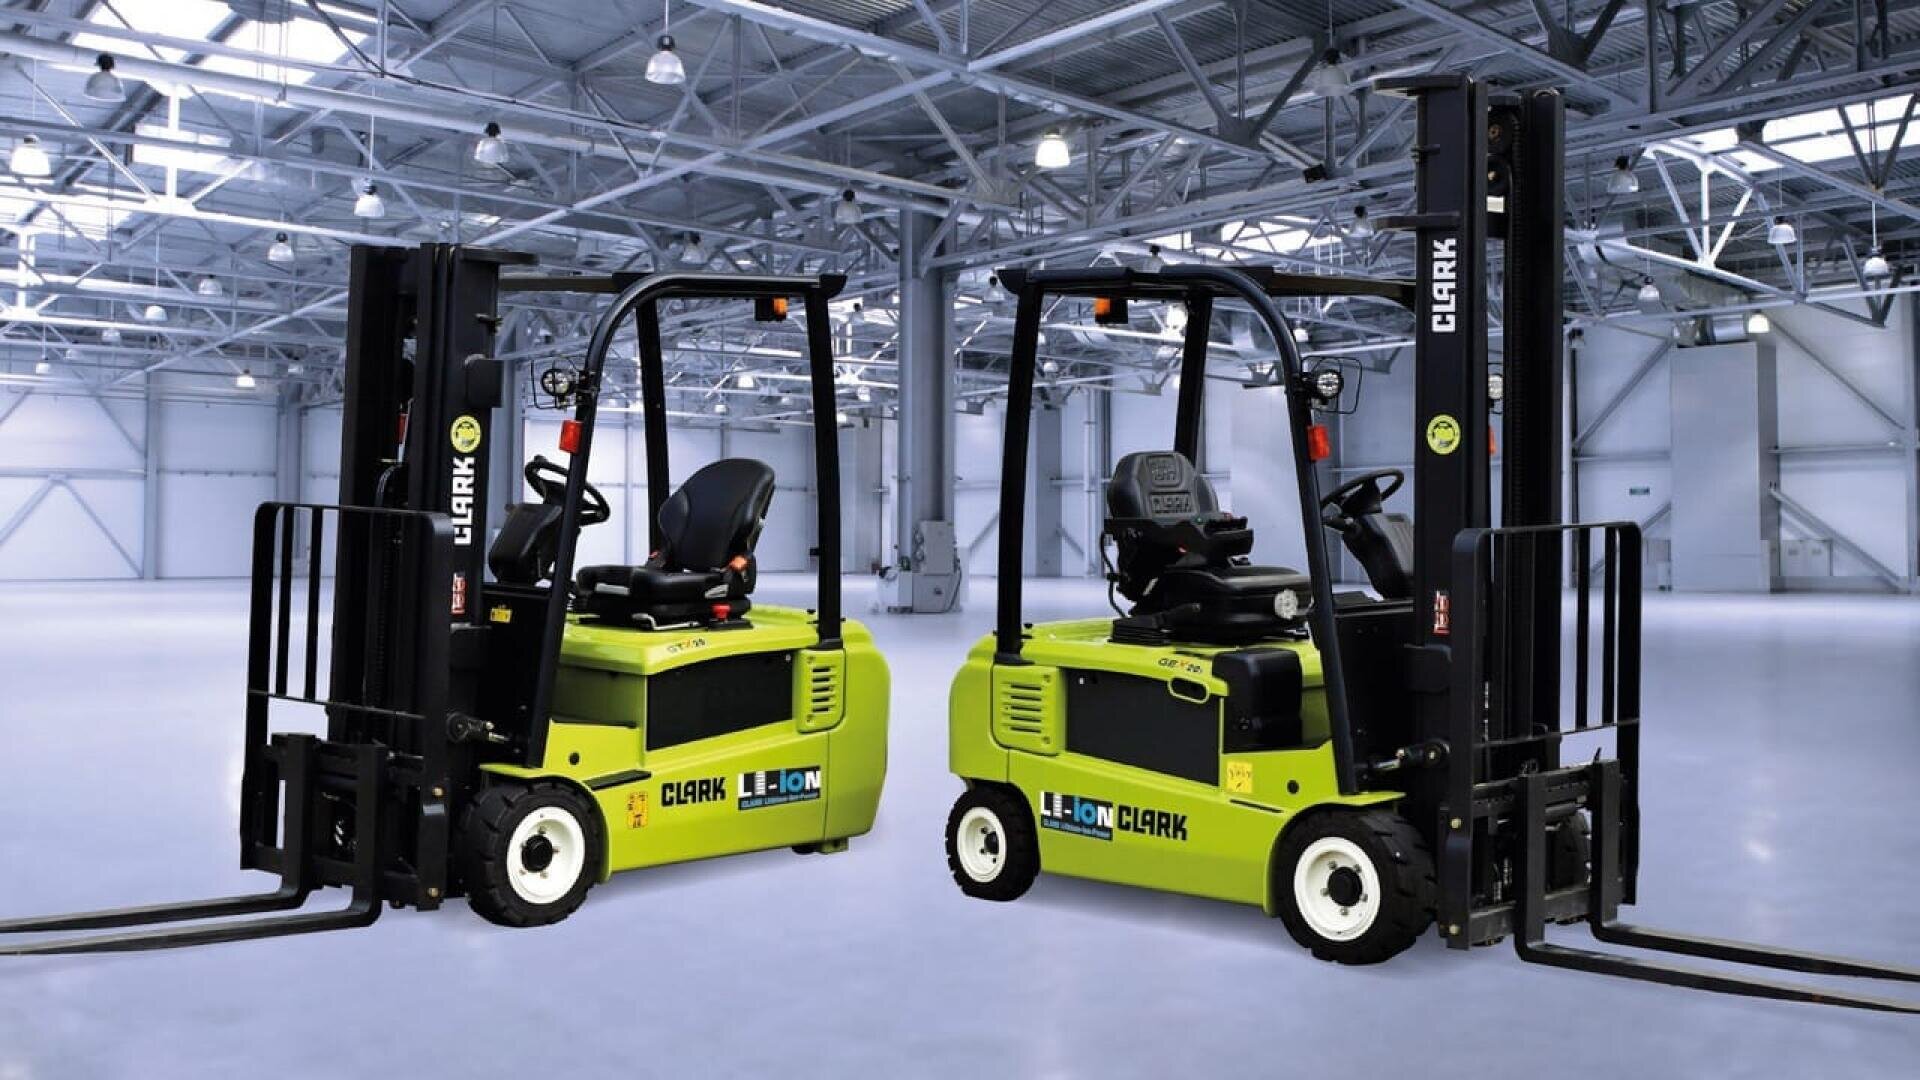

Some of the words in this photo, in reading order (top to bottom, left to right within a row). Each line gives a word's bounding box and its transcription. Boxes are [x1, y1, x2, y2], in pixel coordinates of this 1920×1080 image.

[1432, 238, 1456, 333] CLARK
[452, 456, 475, 545] CLARK
[661, 777, 726, 807] CLARK
[1117, 804, 1187, 841] CLARK
